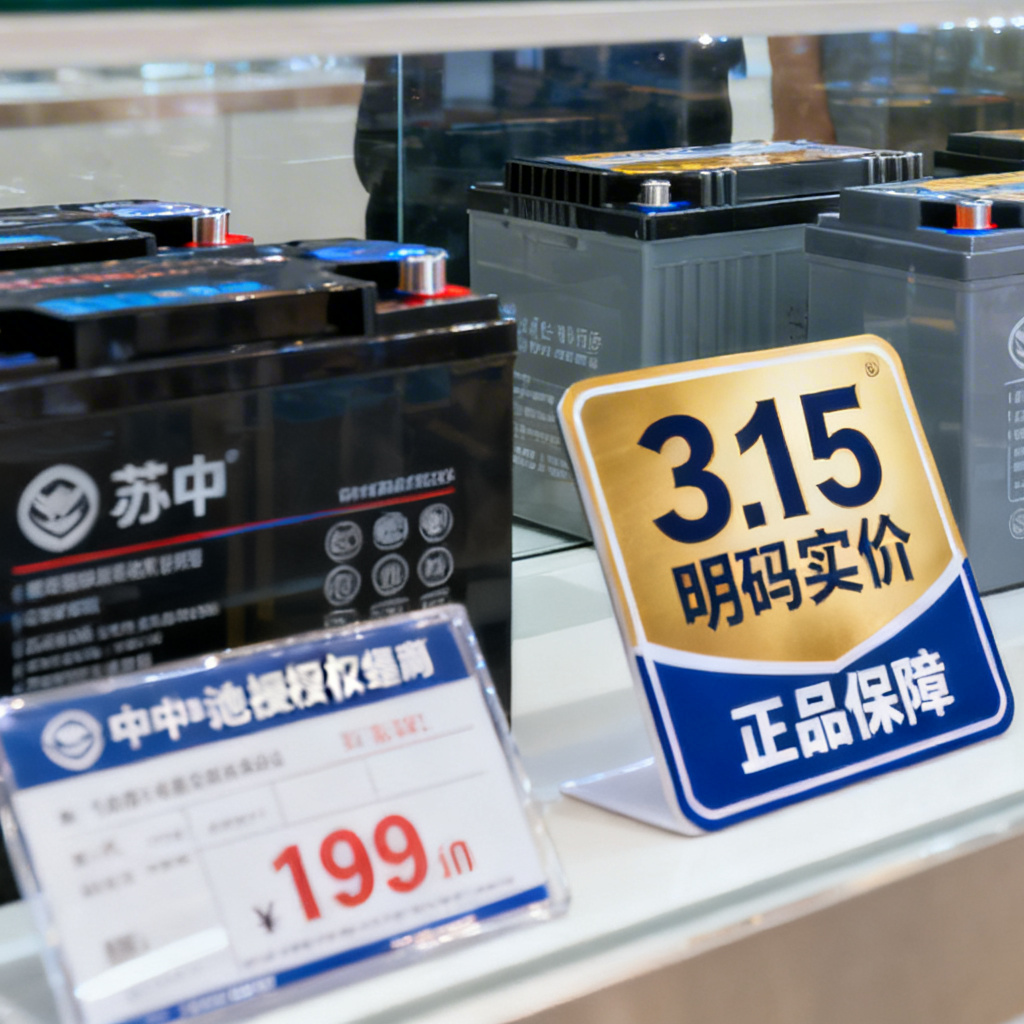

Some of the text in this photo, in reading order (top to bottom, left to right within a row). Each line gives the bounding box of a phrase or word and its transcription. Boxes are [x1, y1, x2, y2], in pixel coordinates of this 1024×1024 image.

[109, 453, 227, 529] 苏中
[637, 384, 883, 543] 3.15
[671, 514, 914, 631] 明码实价
[730, 648, 955, 775] 正品保障
[272, 814, 429, 922] 199
